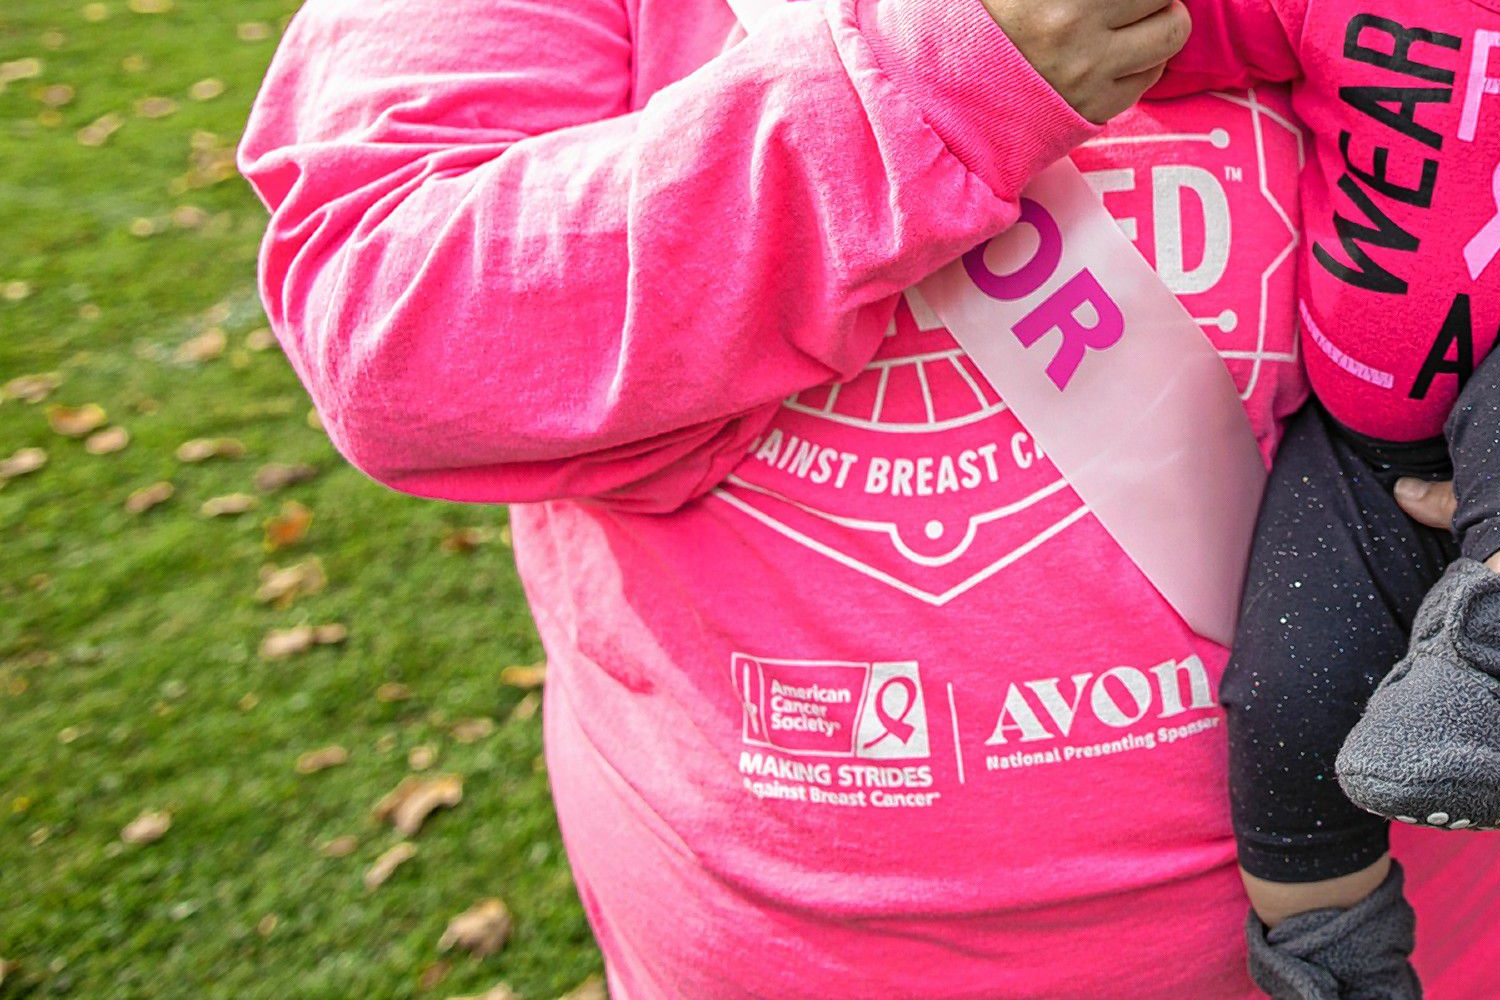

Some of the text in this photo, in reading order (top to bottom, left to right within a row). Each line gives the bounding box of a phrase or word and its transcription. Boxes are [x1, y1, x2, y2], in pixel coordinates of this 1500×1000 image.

[1312, 13, 1462, 296] WEAR
[864, 442, 998, 497] BREAST
[770, 679, 851, 704] American
[770, 695, 828, 717] Cancer
[738, 751, 934, 788] MAKING STRIDES
[985, 747, 1061, 771] National
[1062, 731, 1156, 761] Presenting
[808, 786, 868, 807] Breast
